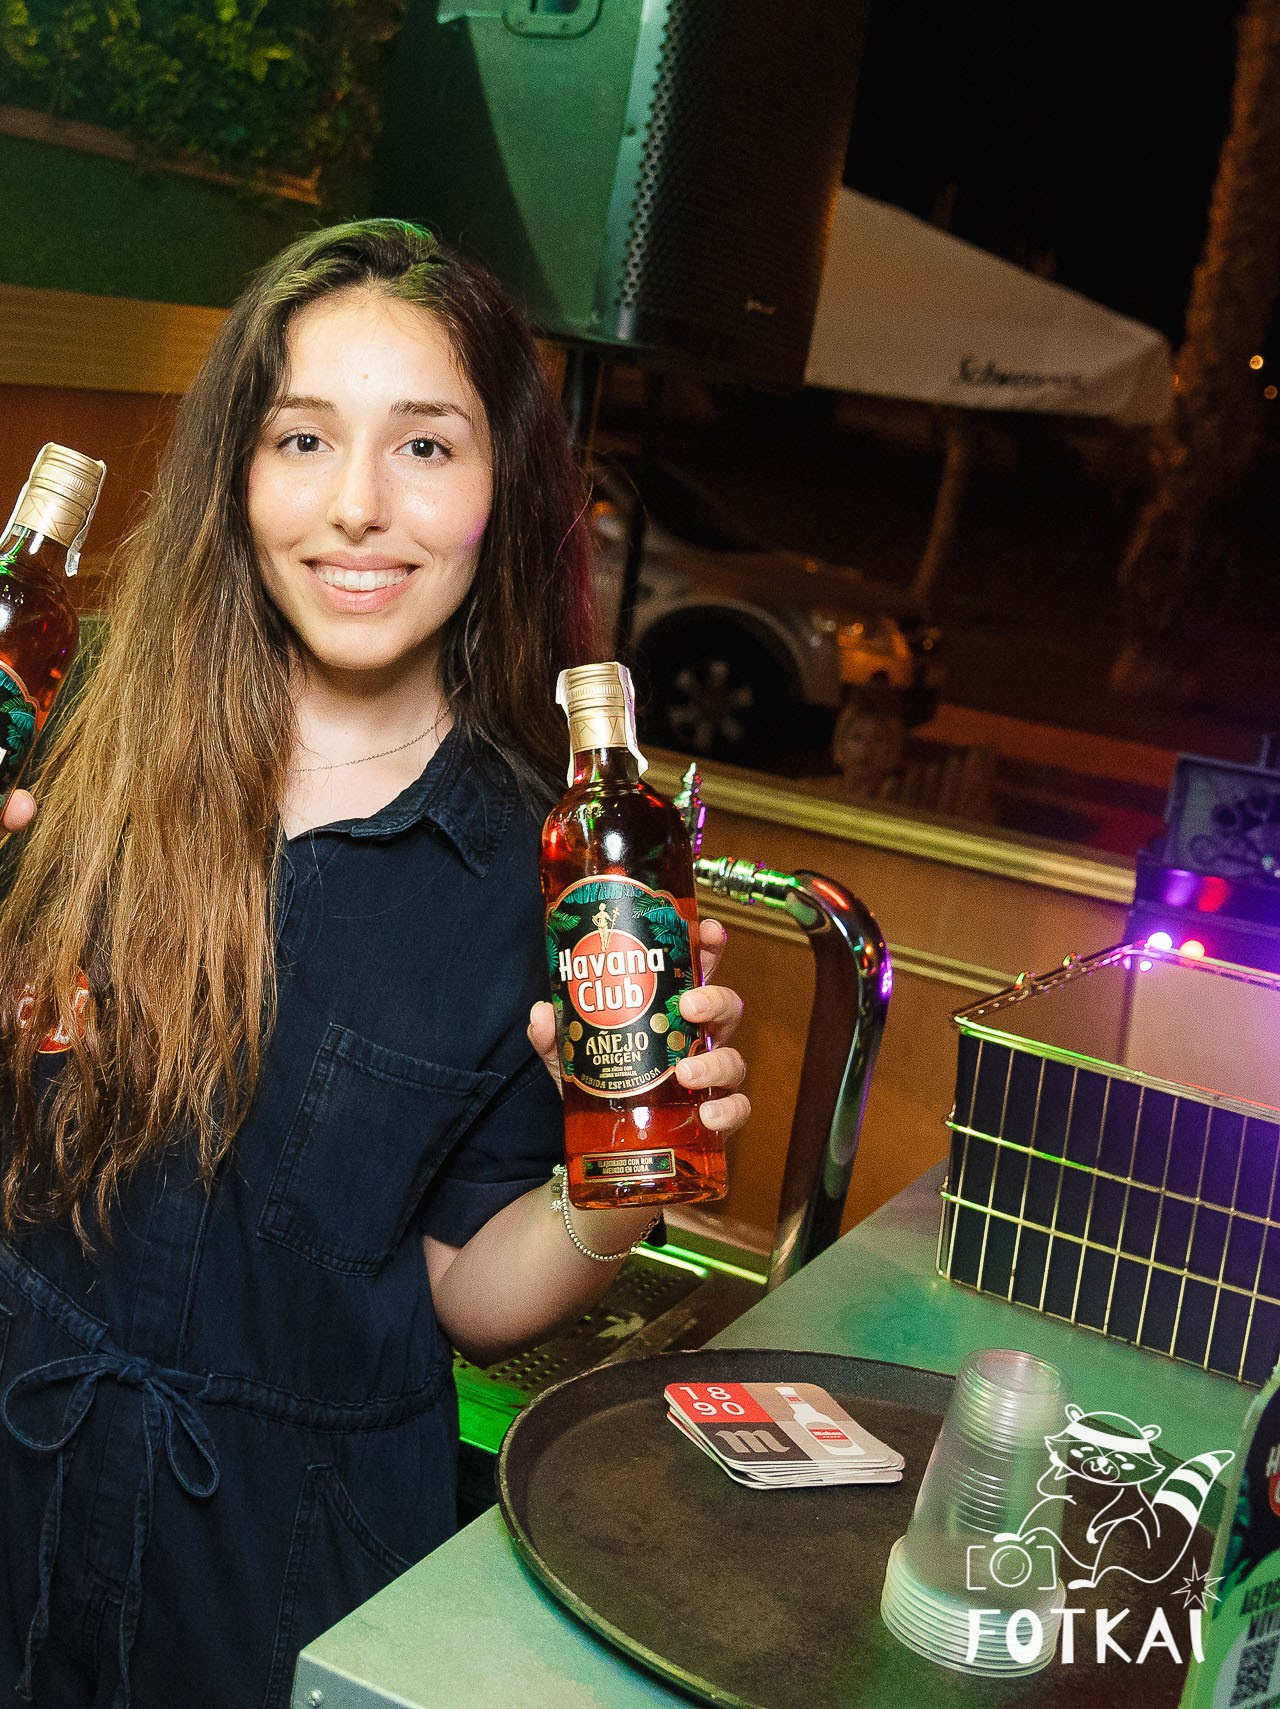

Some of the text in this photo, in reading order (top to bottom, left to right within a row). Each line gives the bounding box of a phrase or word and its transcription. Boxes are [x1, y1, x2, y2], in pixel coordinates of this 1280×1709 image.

[559, 948, 665, 982] Havana
[577, 976, 644, 1013] Club
[586, 1030, 649, 1055] AÑEJO
[592, 1051, 642, 1066] ORIGEN
[608, 1067, 661, 1090] ESPIRITUOSA
[627, 1158, 640, 1166] CON
